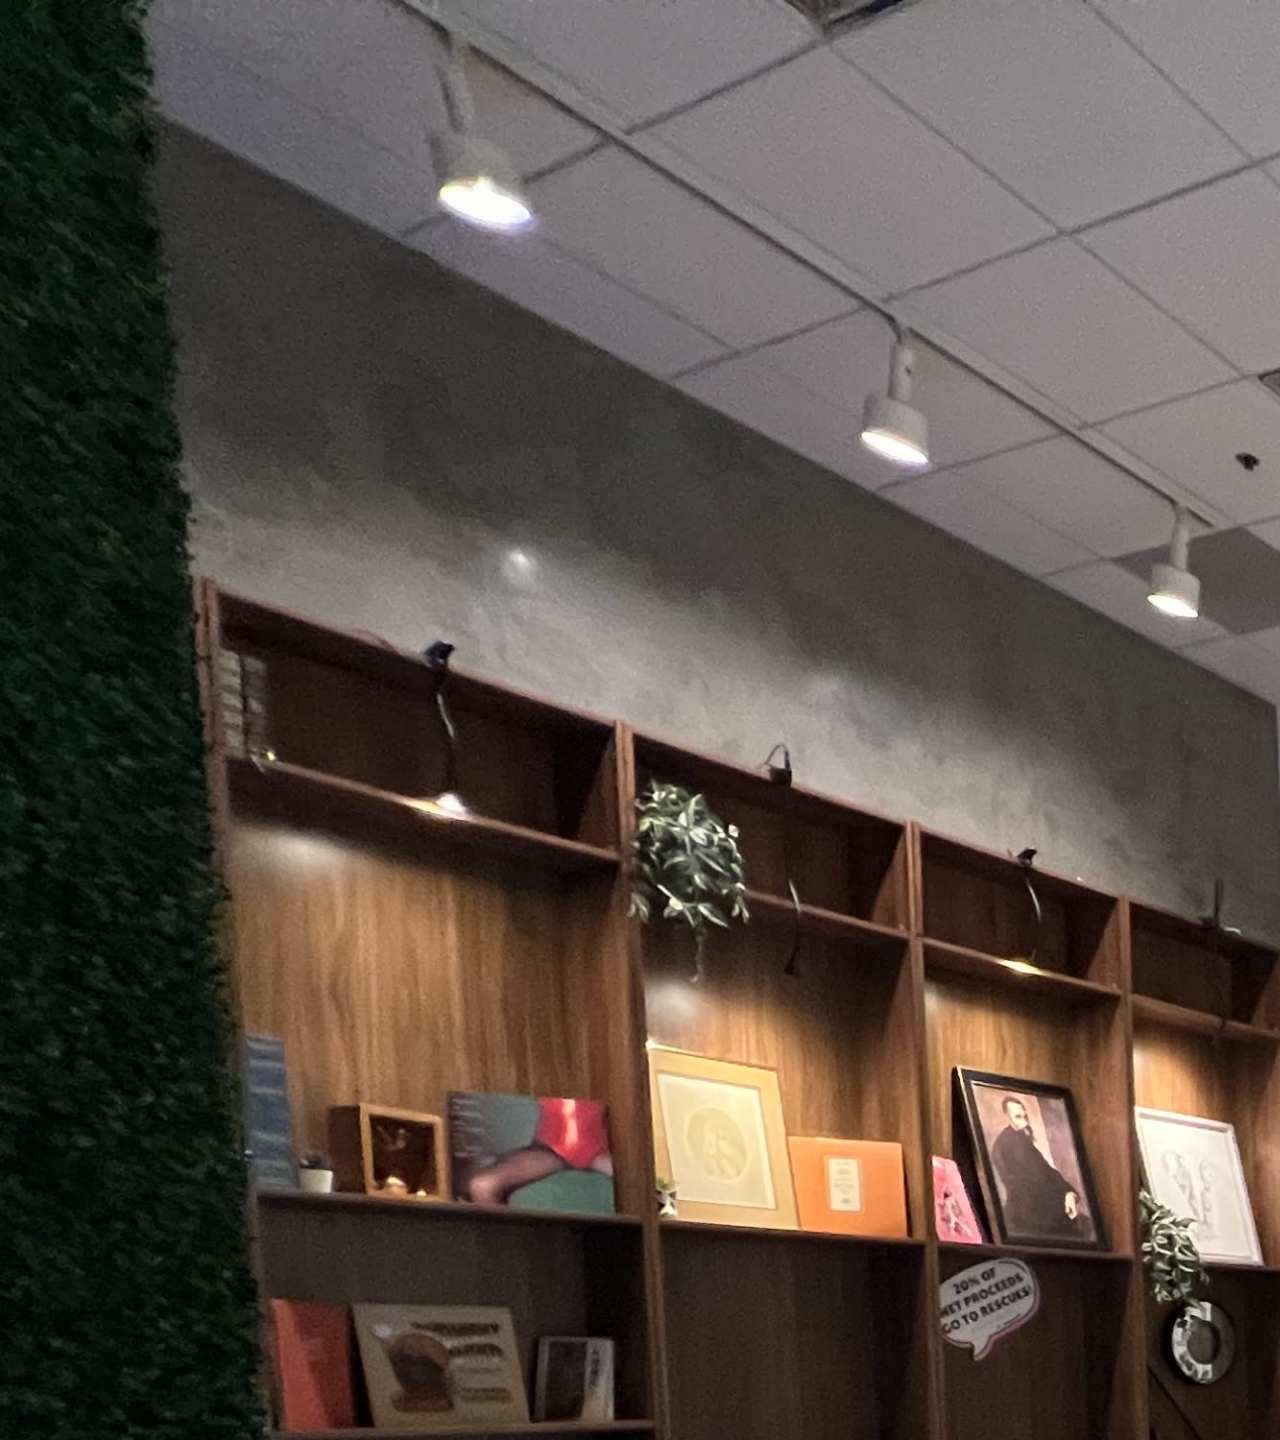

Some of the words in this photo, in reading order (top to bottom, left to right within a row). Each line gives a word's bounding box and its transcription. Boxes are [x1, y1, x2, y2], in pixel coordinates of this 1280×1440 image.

[981, 1266, 996, 1282] OF
[963, 1273, 1024, 1306] PROCEEDS
[961, 1310, 979, 1325] TO
